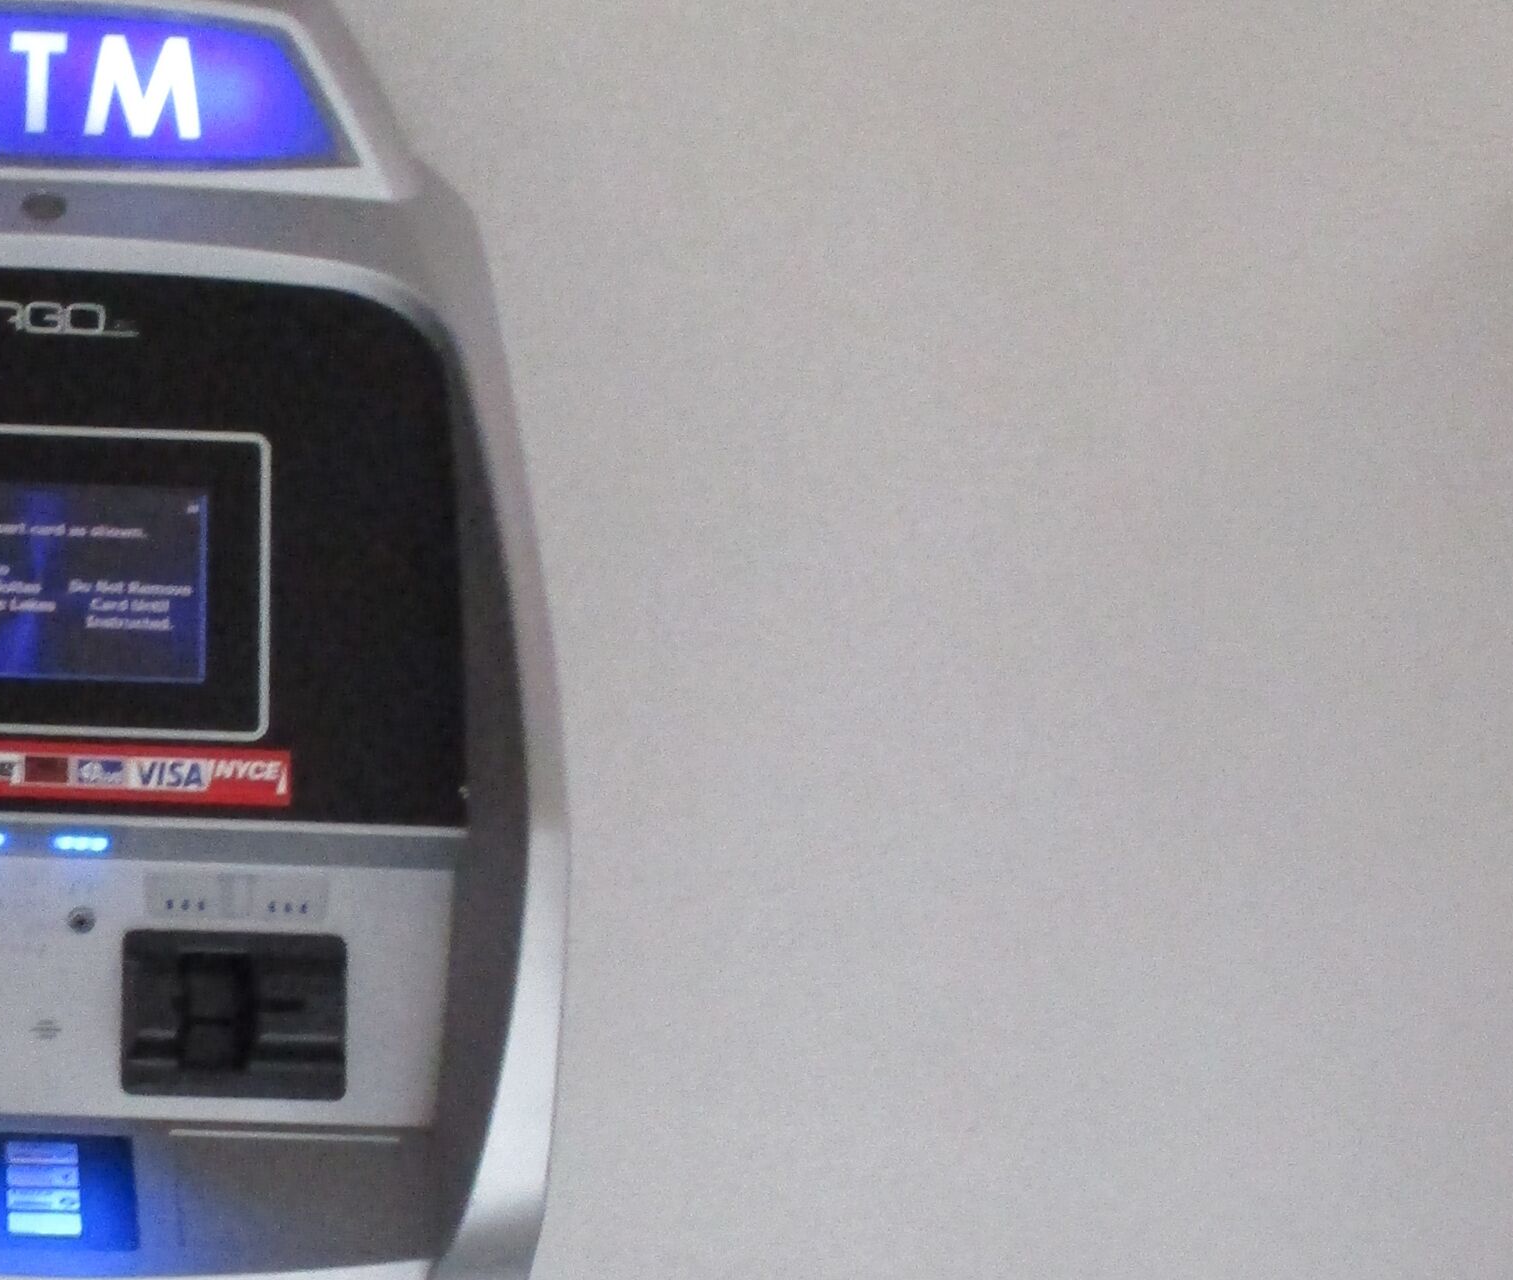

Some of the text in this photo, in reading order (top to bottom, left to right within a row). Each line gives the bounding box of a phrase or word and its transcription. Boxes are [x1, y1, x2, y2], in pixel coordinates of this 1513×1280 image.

[68, 578, 193, 597] Do Not Remove
[90, 597, 129, 612] Card
[138, 761, 204, 788] VISA
[213, 759, 282, 781] NYCE
